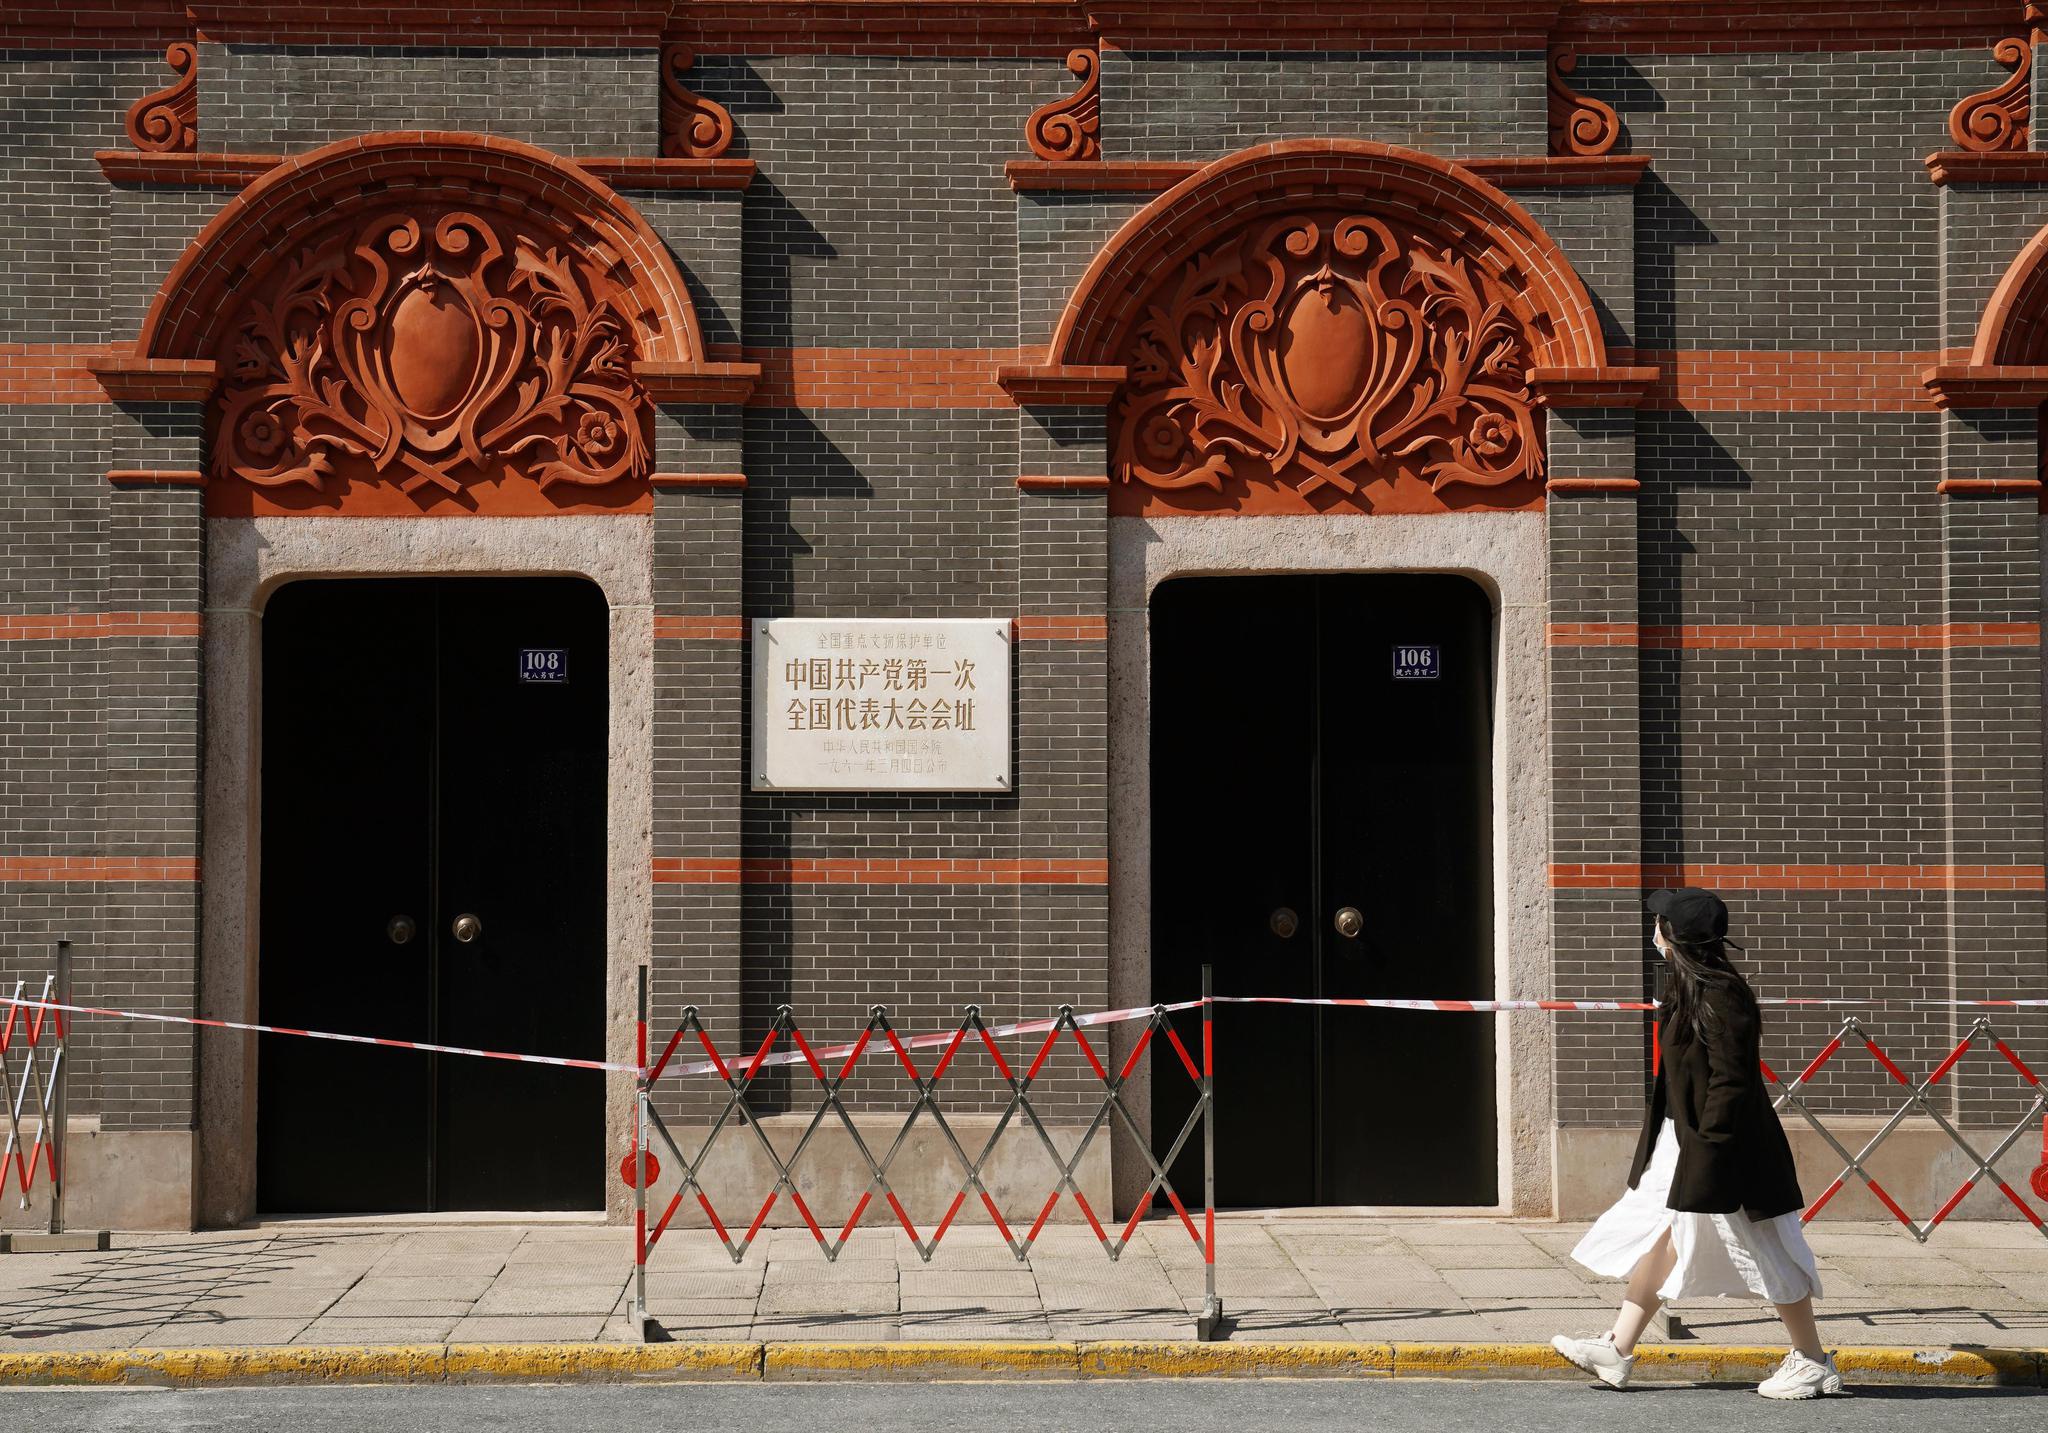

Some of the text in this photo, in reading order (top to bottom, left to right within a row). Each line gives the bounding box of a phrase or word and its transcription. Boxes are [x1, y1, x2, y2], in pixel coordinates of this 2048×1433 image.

[817, 632, 948, 650] 全国重点文物保护单位
[527, 652, 559, 670] 108
[1399, 648, 1432, 667] 106
[785, 658, 977, 691] 中国共产党第一次
[786, 696, 977, 731] 全国代表大会会址
